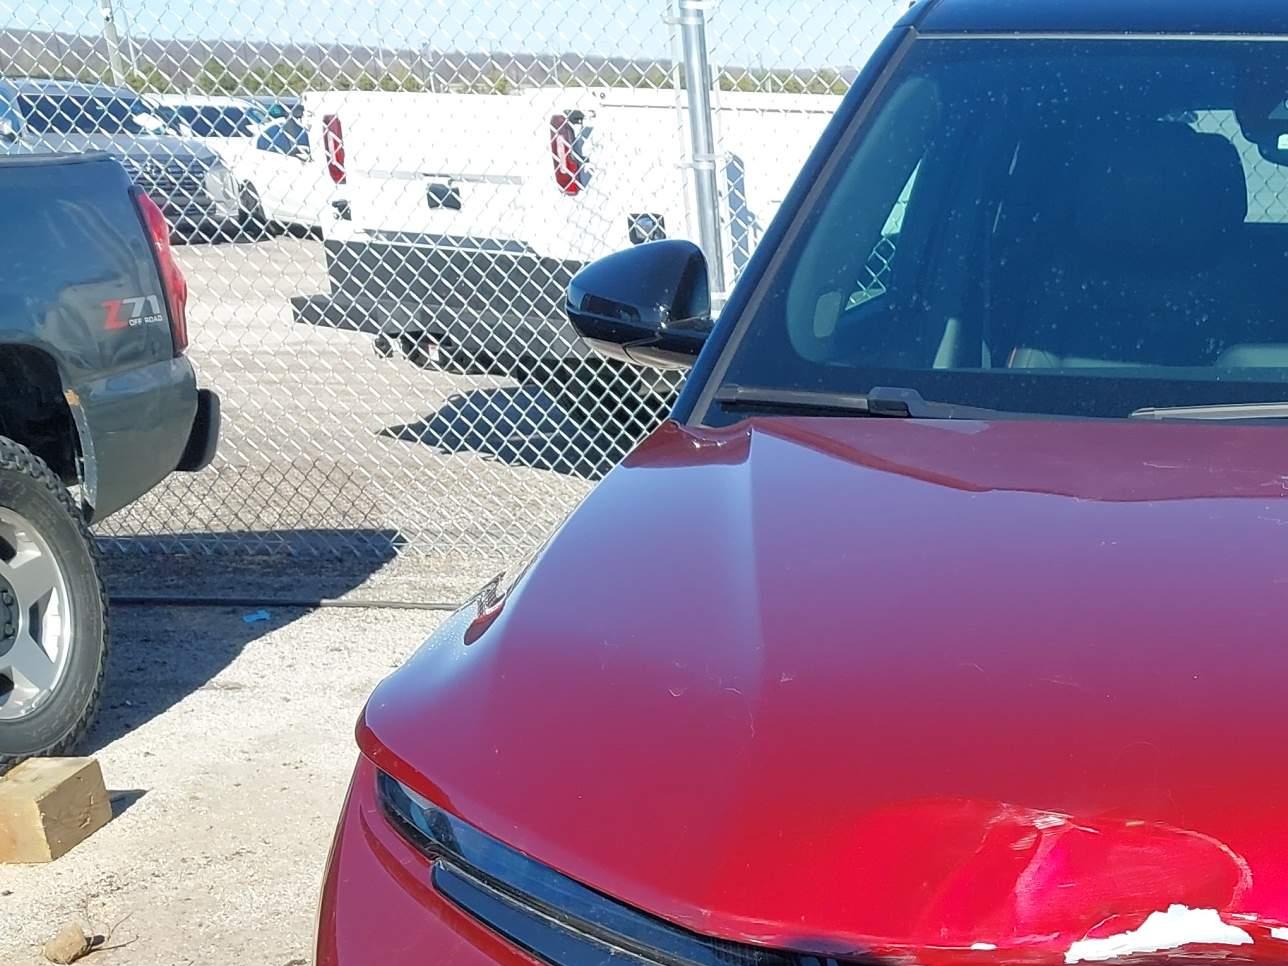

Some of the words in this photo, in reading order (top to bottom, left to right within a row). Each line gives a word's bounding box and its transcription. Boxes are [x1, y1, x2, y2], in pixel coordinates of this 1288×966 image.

[98, 294, 161, 330] Z71
[128, 318, 143, 327] OFF
[144, 314, 163, 323] ROAD
